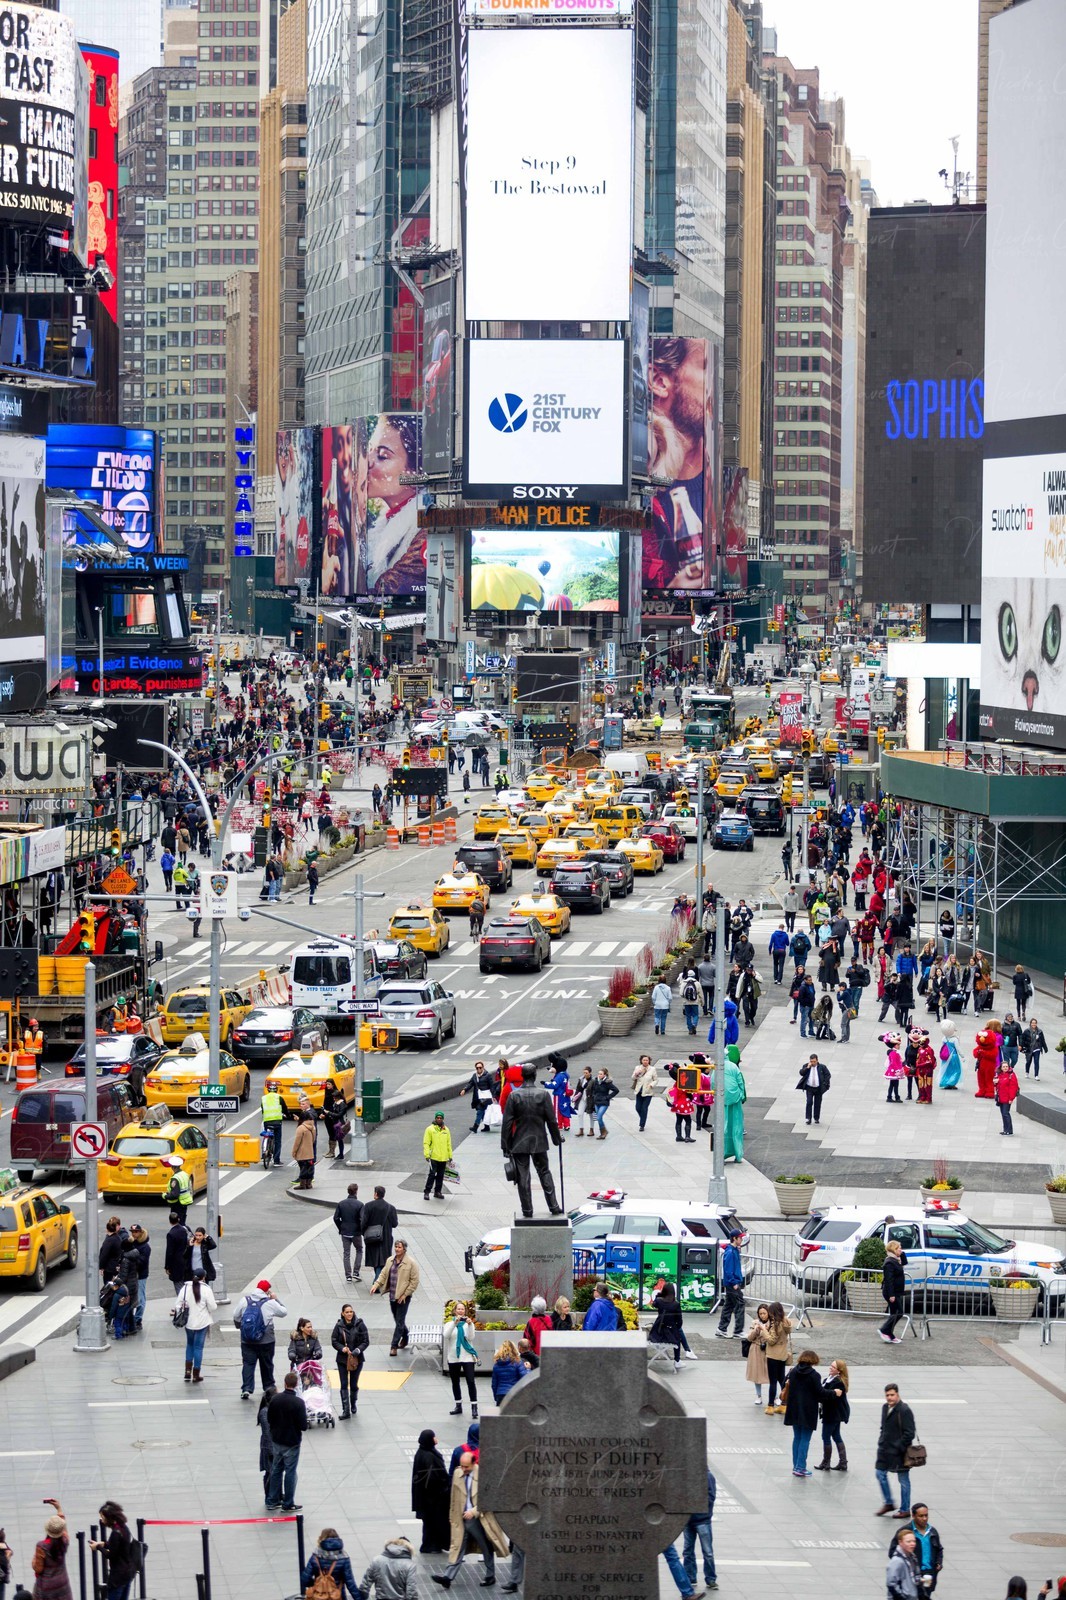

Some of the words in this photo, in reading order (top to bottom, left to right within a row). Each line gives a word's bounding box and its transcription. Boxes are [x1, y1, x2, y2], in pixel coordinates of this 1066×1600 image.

[5, 52, 54, 95] PAST
[26, 147, 74, 195] FUTURE
[521, 155, 560, 175] Step
[566, 155, 576, 170] 9
[490, 180, 523, 195] The
[530, 180, 607, 195] Bestowal
[20, 195, 30, 209] 50
[31, 195, 49, 212] NYC
[533, 393, 566, 406] 21ST
[532, 407, 602, 420] CENTURY
[885, 378, 984, 440] SOPHIS
[532, 420, 561, 433] FOX
[512, 486, 579, 499] SONY
[537, 505, 591, 525] POLICE
[991, 504, 1027, 531] swatch
[781, 702, 801, 716] JERSEY
[782, 713, 798, 726] BOYS
[446, 989, 523, 999] NLY
[362, 1002, 375, 1010] WAY
[464, 1044, 551, 1056] ONL
[201, 1085, 209, 1094] W
[209, 1085, 220, 1095] 46
[194, 1100, 210, 1109] ONE
[217, 1100, 235, 1109] WAY
[935, 1261, 983, 1277] NYPD
[532, 1436, 597, 1448] LIEUTENANT
[600, 1436, 651, 1448] COLONEL
[524, 1451, 589, 1465] FRANCIS
[609, 1451, 664, 1466] DUFFY
[532, 1470, 552, 1480] MAY
[591, 1470, 617, 1480] JUNE
[541, 1487, 597, 1498] CATHOLIC
[604, 1487, 645, 1498] PRIEST
[565, 1514, 620, 1525] CHAPLAIN
[555, 1544, 577, 1554] OLD
[543, 1573, 551, 1582] A
[554, 1573, 577, 1582] LIFE
[581, 1573, 596, 1582] OF
[600, 1573, 645, 1583] SERVICE
[582, 1585, 601, 1593] FOR
